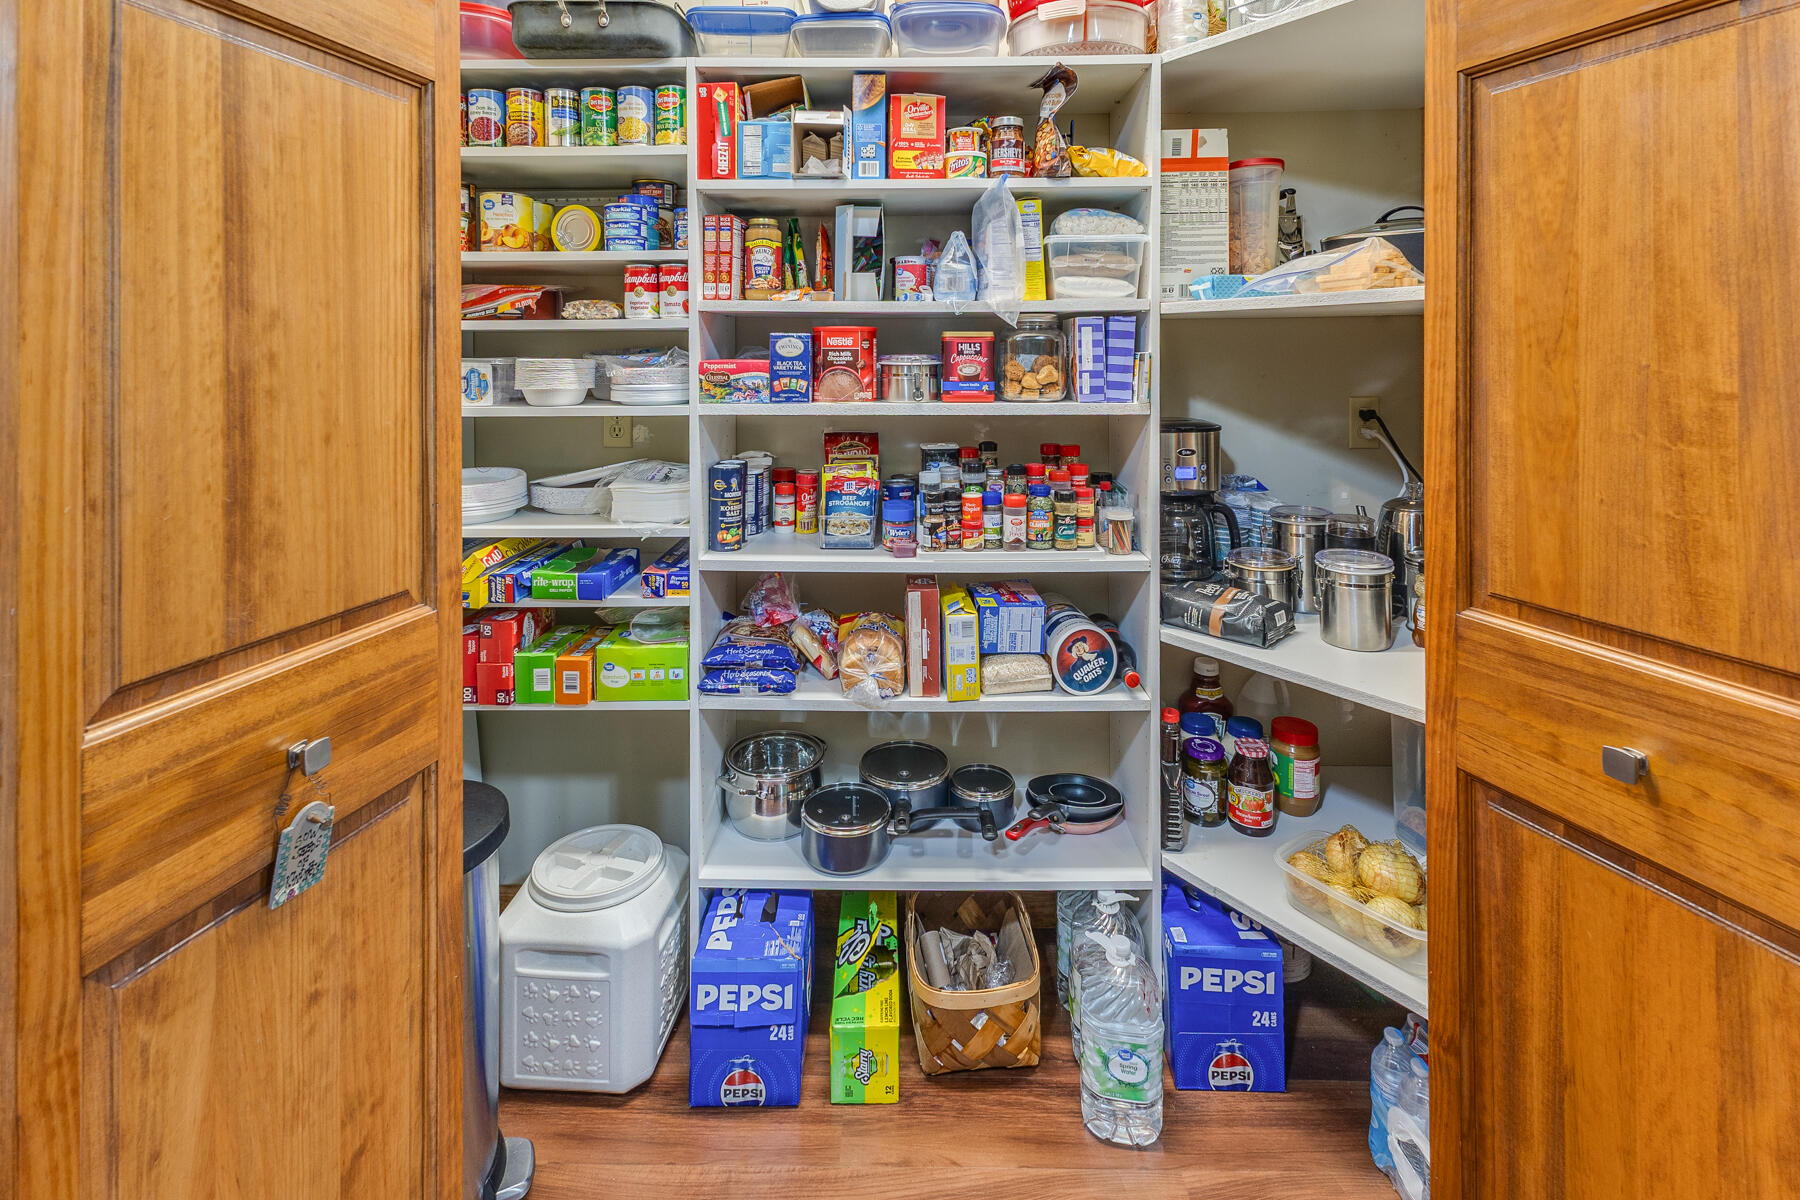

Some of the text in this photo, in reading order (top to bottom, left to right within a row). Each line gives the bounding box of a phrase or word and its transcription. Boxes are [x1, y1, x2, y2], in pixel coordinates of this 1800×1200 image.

[907, 104, 930, 114] Orville
[993, 147, 1022, 159] HERSHEY'S
[949, 158, 969, 171] Fritos
[958, 343, 981, 351] HILLS
[950, 353, 988, 364] Cappuccino
[703, 362, 736, 370] Peppermint
[482, 548, 503, 568] GLAD
[725, 647, 775, 656] Herb Seasoned
[1083, 667, 1103, 683] OATS
[463, 687, 472, 702] 100
[497, 692, 505, 703] 50
[1180, 965, 1276, 996] PEPSI
[696, 983, 794, 1012] PEPSI
[1251, 1010, 1278, 1028] 24 CANS
[769, 1024, 795, 1041] 24 CANS
[854, 1048, 873, 1086] Starry
[1119, 1062, 1138, 1072] Spring
[1211, 1069, 1251, 1082] PEPSI
[723, 1088, 763, 1099] PEPSI
[885, 1085, 892, 1095] 12
